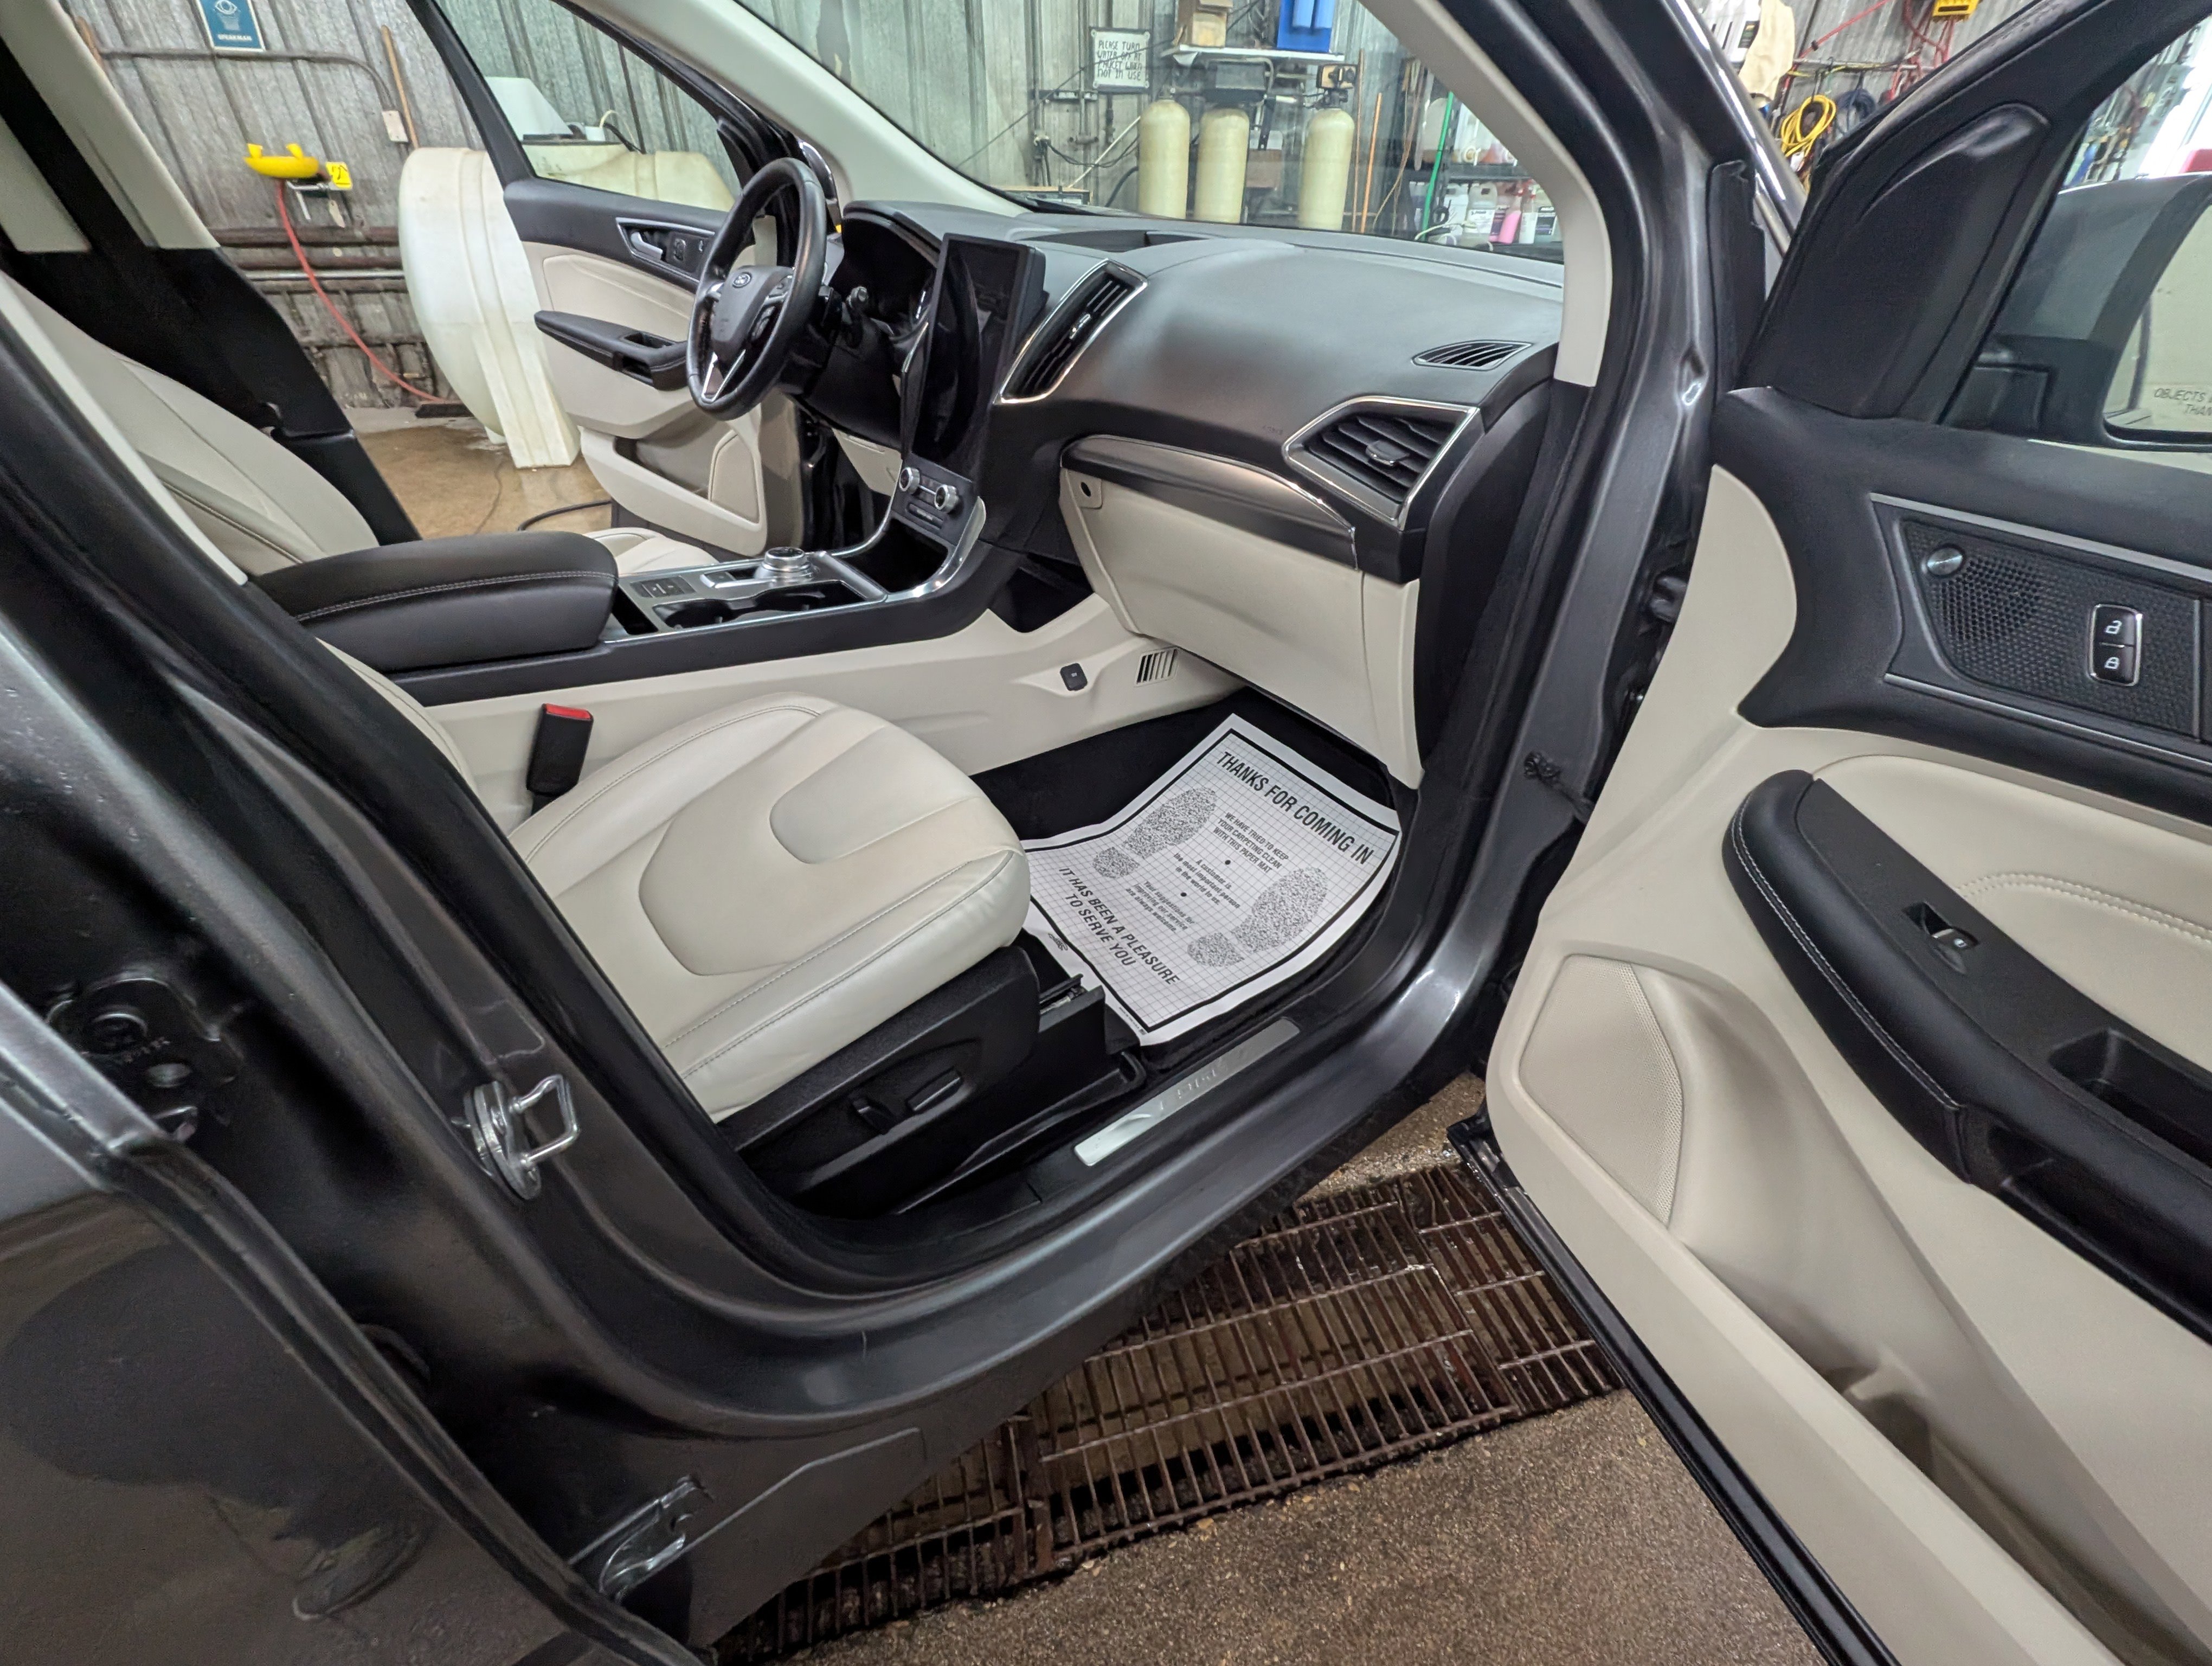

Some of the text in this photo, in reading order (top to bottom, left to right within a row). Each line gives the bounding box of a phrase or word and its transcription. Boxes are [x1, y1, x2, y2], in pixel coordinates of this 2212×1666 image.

[1098, 40, 1118, 50] PLEASE
[1128, 71, 1141, 81] USE
[2154, 388, 2205, 402] OBJECTS
[1217, 751, 1374, 864] THANKS FOR COMING IN
[1213, 826, 1272, 873] WITH THIS PAPER MAT
[1218, 818, 1282, 869] YOUR CARPETING CLEAN
[1225, 812, 1289, 860] WE HAVE TRIED TO KEEP
[1174, 853, 1240, 908] the most important person
[1181, 871, 1191, 880] the
[1190, 879, 1207, 892] world
[1211, 896, 1220, 905] us.
[1200, 864, 1226, 884] customer
[1126, 888, 1136, 896] are
[1134, 896, 1153, 912] always
[1134, 883, 1159, 906] improving
[1167, 913, 1188, 930] service
[1144, 881, 1156, 892] Your
[1154, 892, 1186, 918] suggestions
[1065, 893, 1136, 965] TO SERVE YOU
[1069, 878, 1093, 897] HAS
[1088, 898, 1118, 924] BEEN
[1120, 933, 1180, 984] PLEASURE
